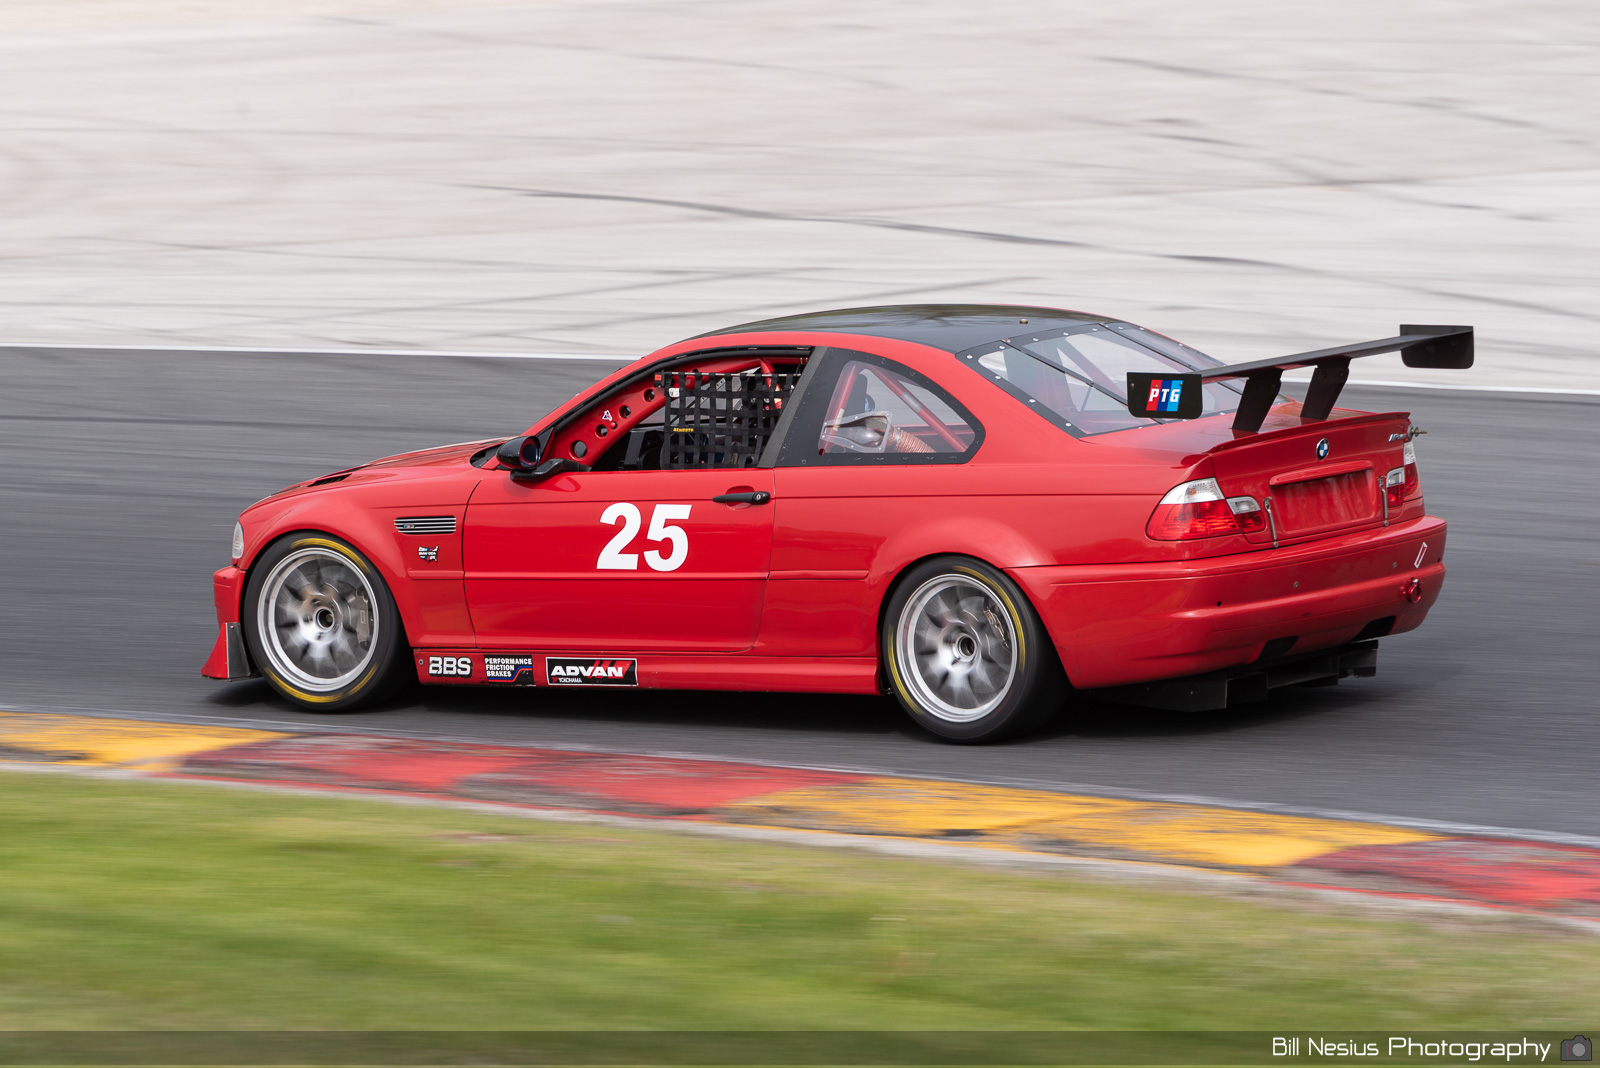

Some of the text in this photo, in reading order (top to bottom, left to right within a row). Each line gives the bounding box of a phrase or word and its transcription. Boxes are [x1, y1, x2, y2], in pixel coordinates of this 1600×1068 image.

[1149, 389, 1180, 402] PTG
[596, 502, 692, 572] 25
[428, 656, 472, 676] BBS
[484, 657, 533, 665] PERFORMANCE
[550, 665, 624, 678] ADVAN
